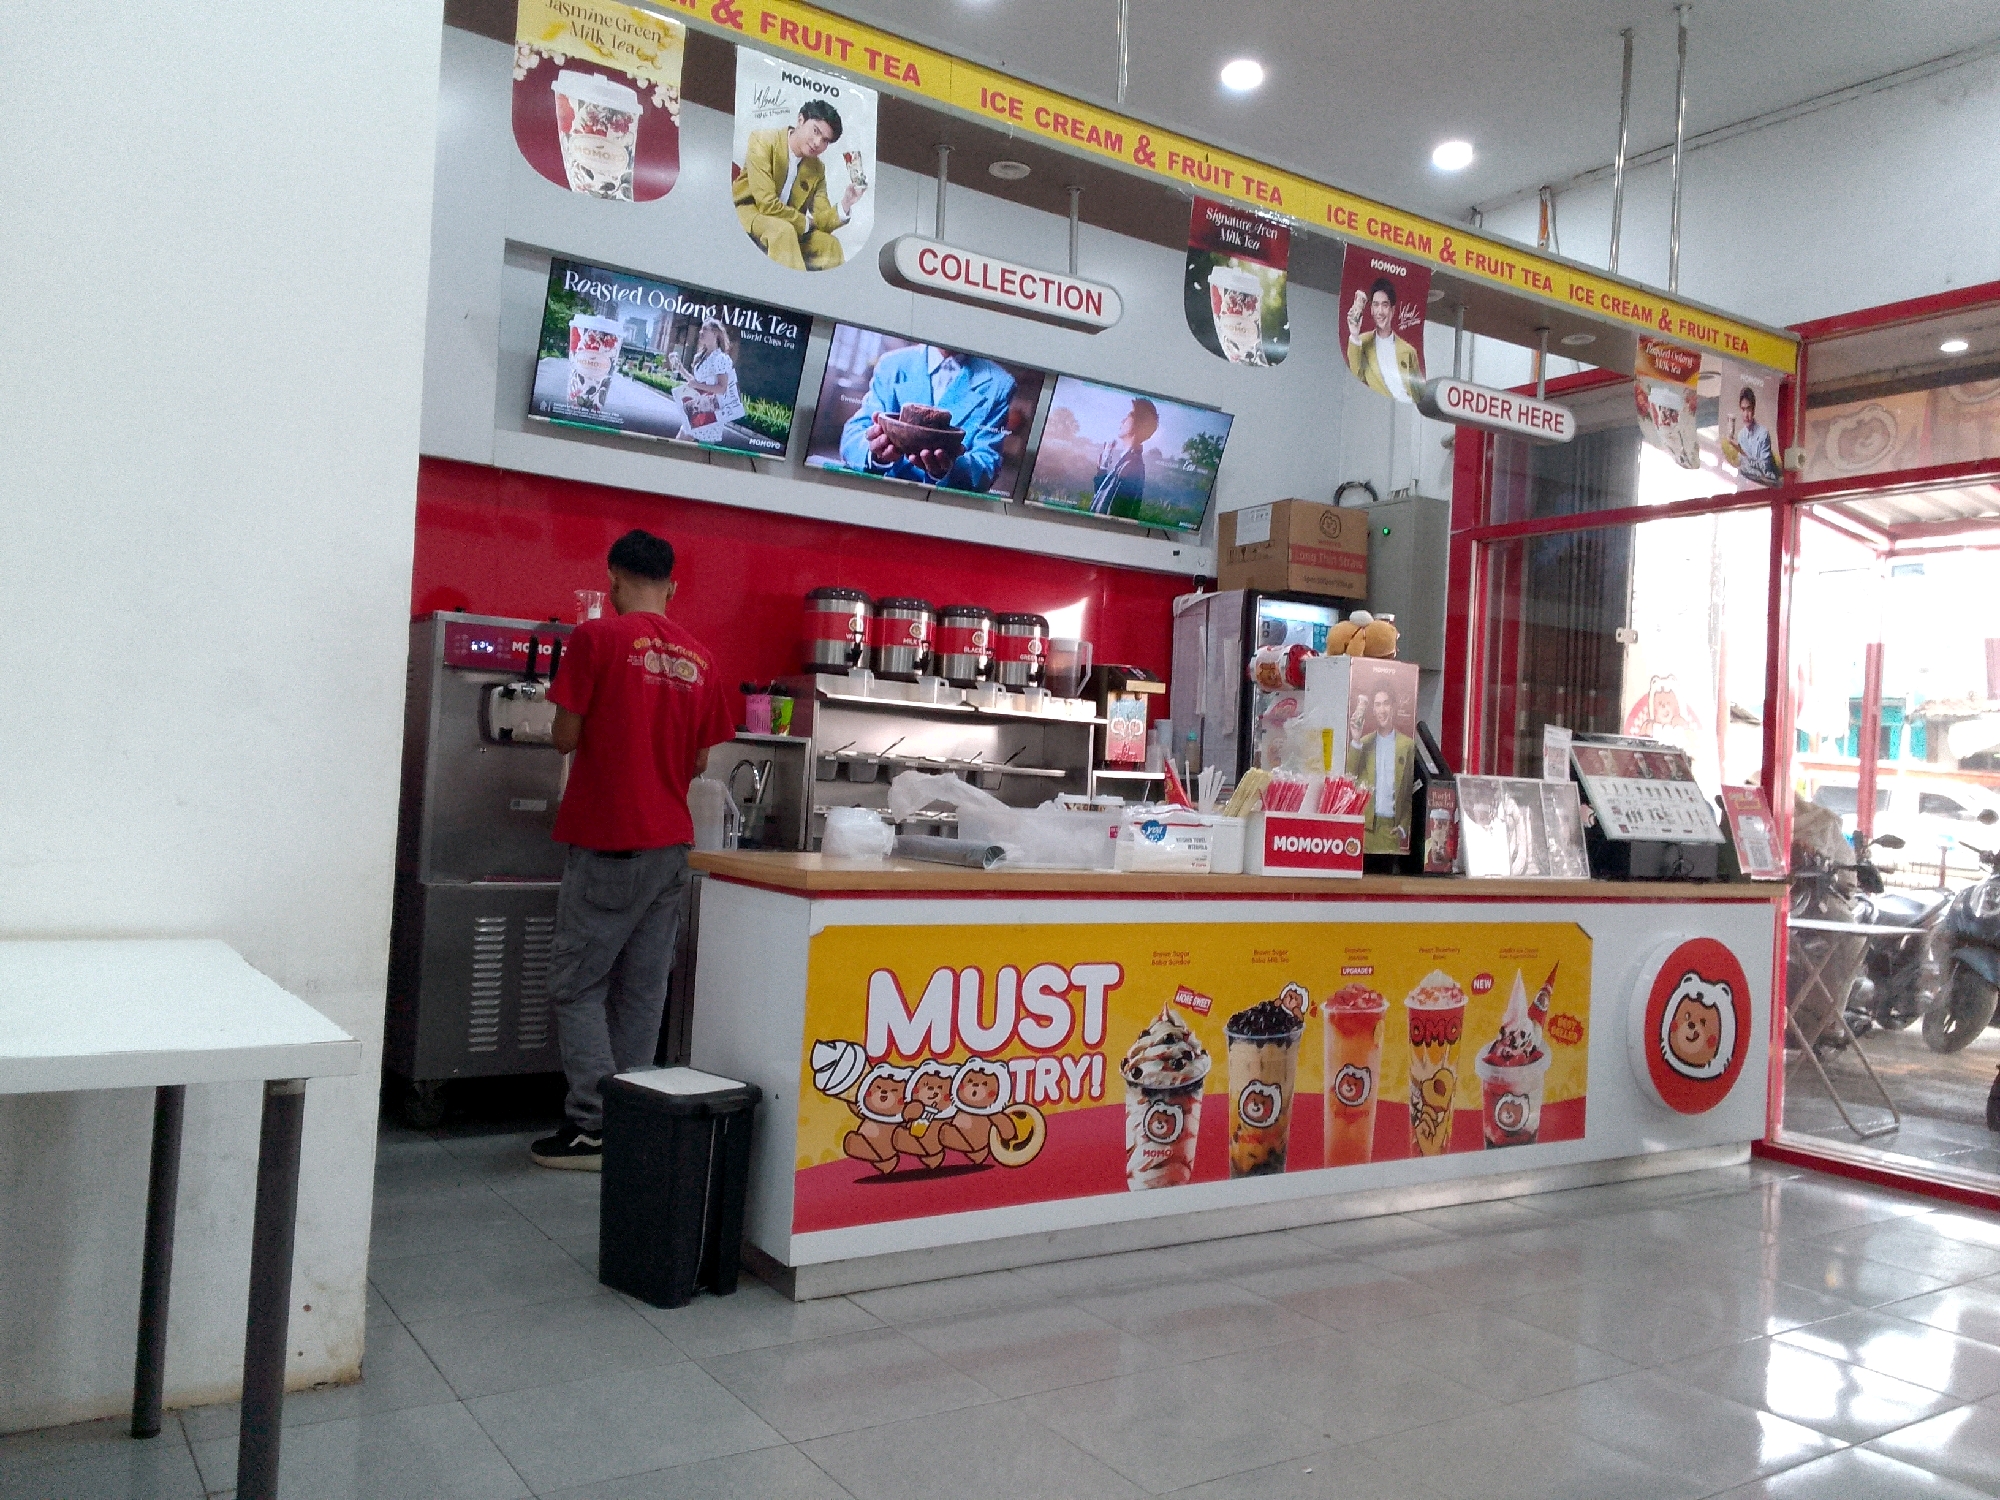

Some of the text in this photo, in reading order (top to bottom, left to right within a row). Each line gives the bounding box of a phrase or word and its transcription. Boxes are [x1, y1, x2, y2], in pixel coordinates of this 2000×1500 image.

[570, 21, 636, 55] Milk Tea
[615, 14, 661, 43] Green
[760, 11, 854, 62] FRUIT
[864, 47, 921, 87] TEA
[781, 71, 840, 98] MOMOYO
[981, 87, 1283, 206] ICE CREAM & FRUIT TEA
[1206, 207, 1251, 231] Signature
[1220, 228, 1261, 251] Milk Tea
[1326, 204, 1553, 293] ICE CREAM & FRUIT TEA
[918, 248, 1102, 317] COLLECTION
[1371, 258, 1407, 277] MOMOYO
[564, 270, 798, 339] Roasted Oolong Milk Tea
[1569, 284, 1749, 355] ICE CREAM & FRUIT TEA
[1447, 386, 1565, 434] ORDER HERE
[749, 438, 780, 449] MOMOYO
[1274, 836, 1344, 854] MOMOYO
[1473, 979, 1492, 989] NEW
[866, 963, 1123, 1060] MUST
[1175, 993, 1211, 1010] MORE SWEET
[1010, 1052, 1107, 1103] TRY!
